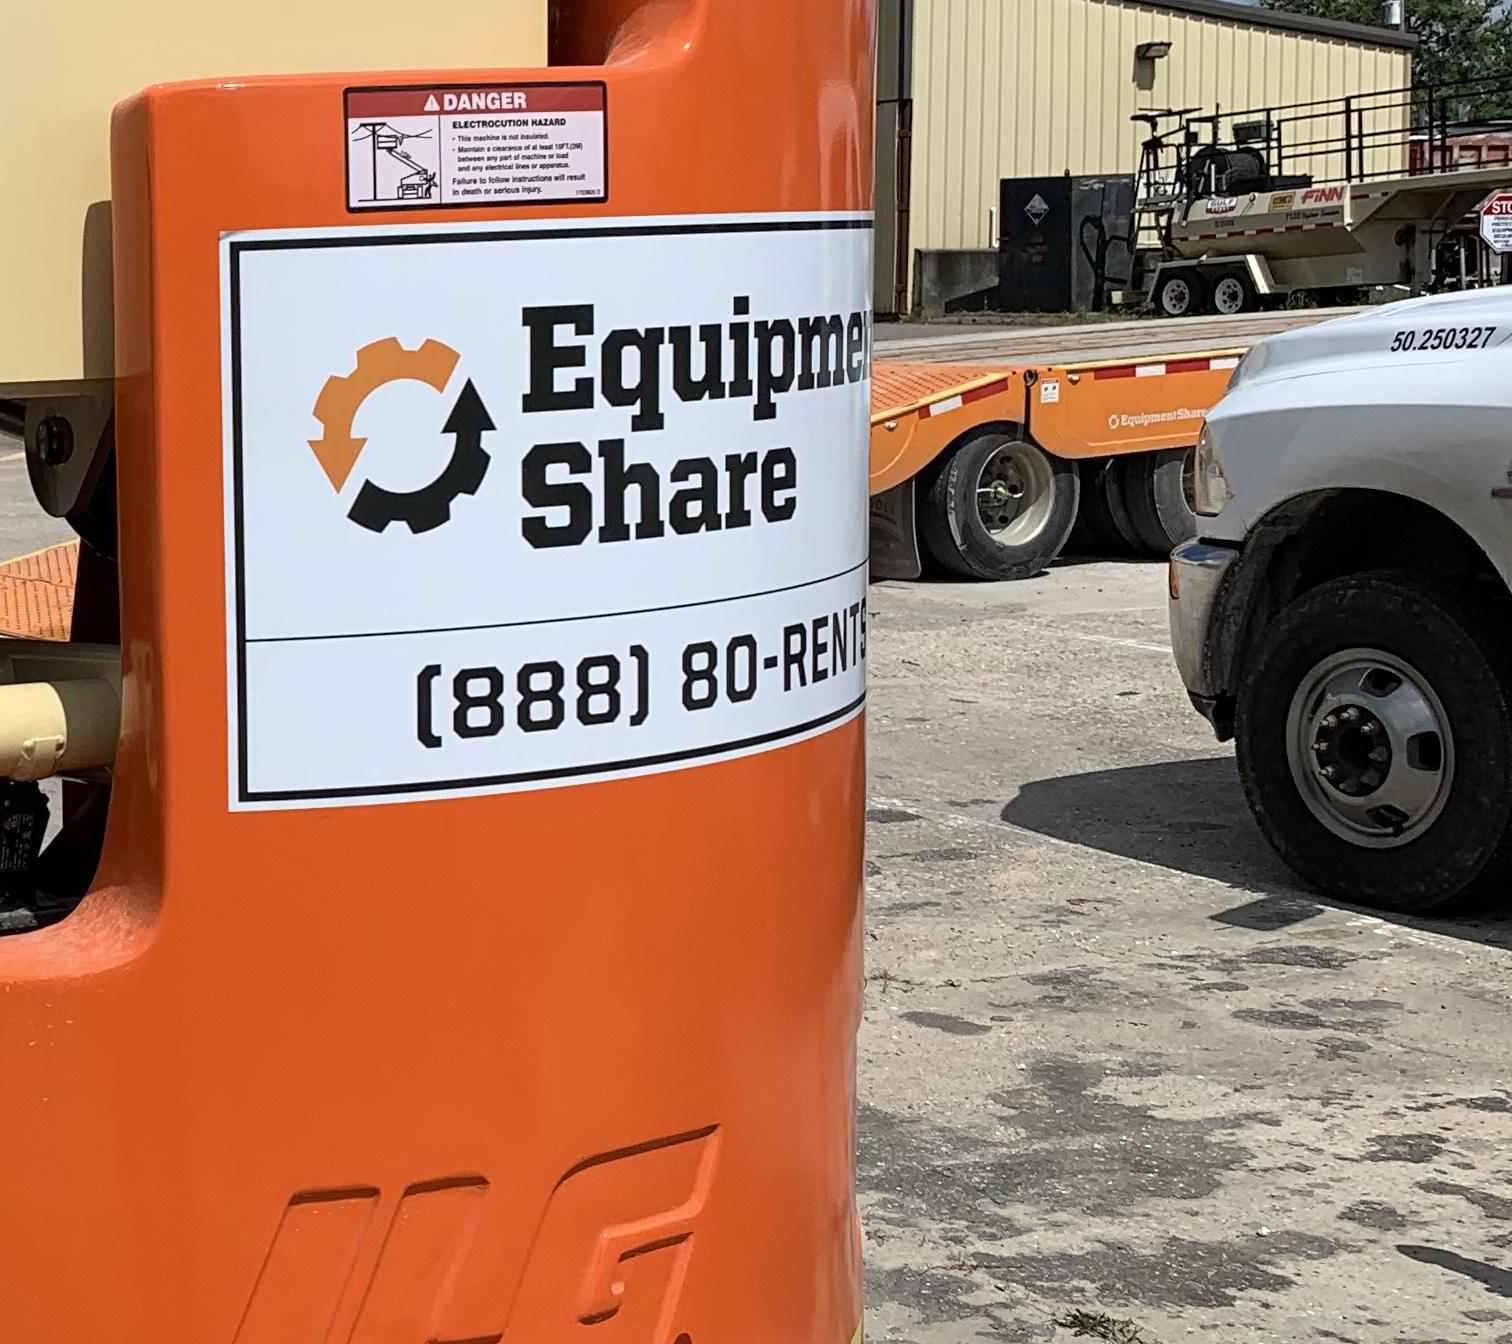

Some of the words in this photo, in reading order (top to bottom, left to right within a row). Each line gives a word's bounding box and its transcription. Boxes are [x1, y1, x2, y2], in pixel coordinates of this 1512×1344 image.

[443, 92, 527, 111] DANGER
[452, 119, 529, 129] ELECTROCUTION
[531, 118, 566, 127] HAZARD
[473, 134, 499, 142] machine
[457, 145, 486, 153] Maintain
[492, 144, 522, 152] clearance
[457, 155, 485, 163] between
[487, 155, 498, 163] any
[499, 154, 512, 162] part
[471, 164, 483, 172] any
[485, 163, 514, 171] electrical
[515, 162, 530, 170] lines
[452, 177, 478, 185] Failure
[488, 176, 510, 184] follow
[512, 174, 552, 183] instructions
[566, 173, 586, 181] result
[461, 188, 482, 196] death
[493, 186, 520, 194] serious
[521, 185, 543, 194] injury.
[1390, 326, 1497, 353] 50.250327
[1121, 407, 1209, 426] EquipmentShare
[522, 438, 797, 549] Share
[417, 644, 649, 749] (888)
[681, 596, 866, 712] 80-RENTS
